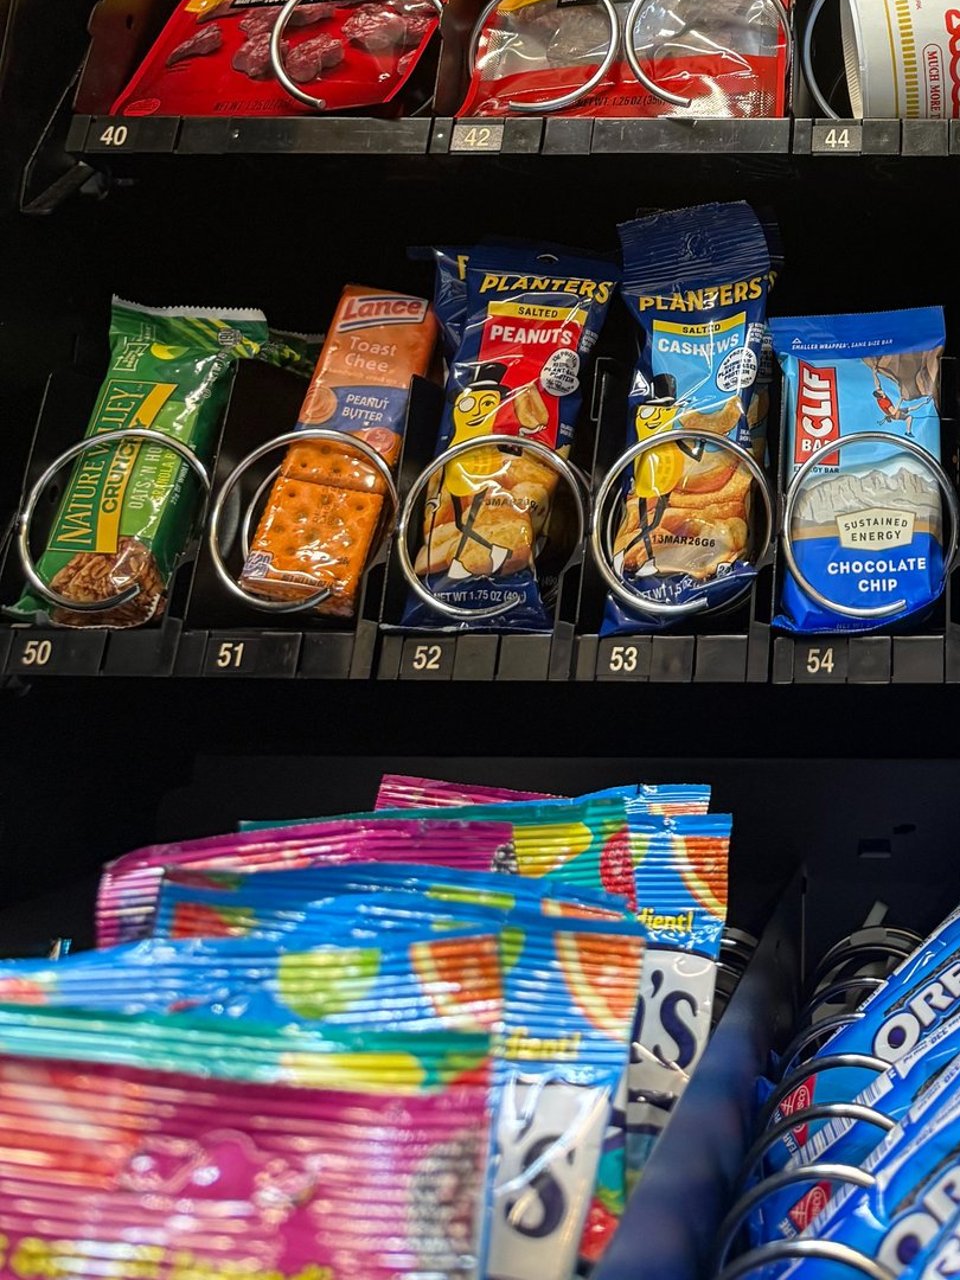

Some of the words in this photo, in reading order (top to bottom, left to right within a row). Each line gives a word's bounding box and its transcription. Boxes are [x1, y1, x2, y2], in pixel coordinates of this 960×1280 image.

[927, 50, 939, 74] MUCH
[929, 75, 941, 103] MORE
[100, 126, 127, 145] 40
[464, 128, 491, 147] 42
[825, 129, 850, 148] 44
[479, 273, 611, 304] PLANTERS
[639, 276, 763, 312] PLANTERS
[342, 297, 424, 321] Lance
[518, 306, 559, 318] SALTED
[489, 324, 574, 346] PEANUTS
[350, 336, 399, 357] Toast
[344, 352, 388, 373] Chee
[345, 393, 391, 410] PEANUT
[801, 367, 834, 438] CLIF
[341, 407, 384, 423] BUTTER
[824, 466, 840, 474] BAR
[56, 459, 106, 545] NATURE
[128, 478, 151, 510] OATS
[843, 516, 909, 532] SUSTAINED
[850, 529, 902, 542] ENERGY
[827, 557, 927, 575] CHOCOLATE
[453, 590, 468, 601] WT
[469, 588, 489, 600] 1.75
[490, 588, 503, 599] OZ
[857, 578, 898, 593] CHIP
[22, 641, 52, 666] 50
[216, 642, 245, 668] 51
[413, 645, 441, 670] 52
[610, 646, 638, 670] 53
[806, 648, 835, 674] 54
